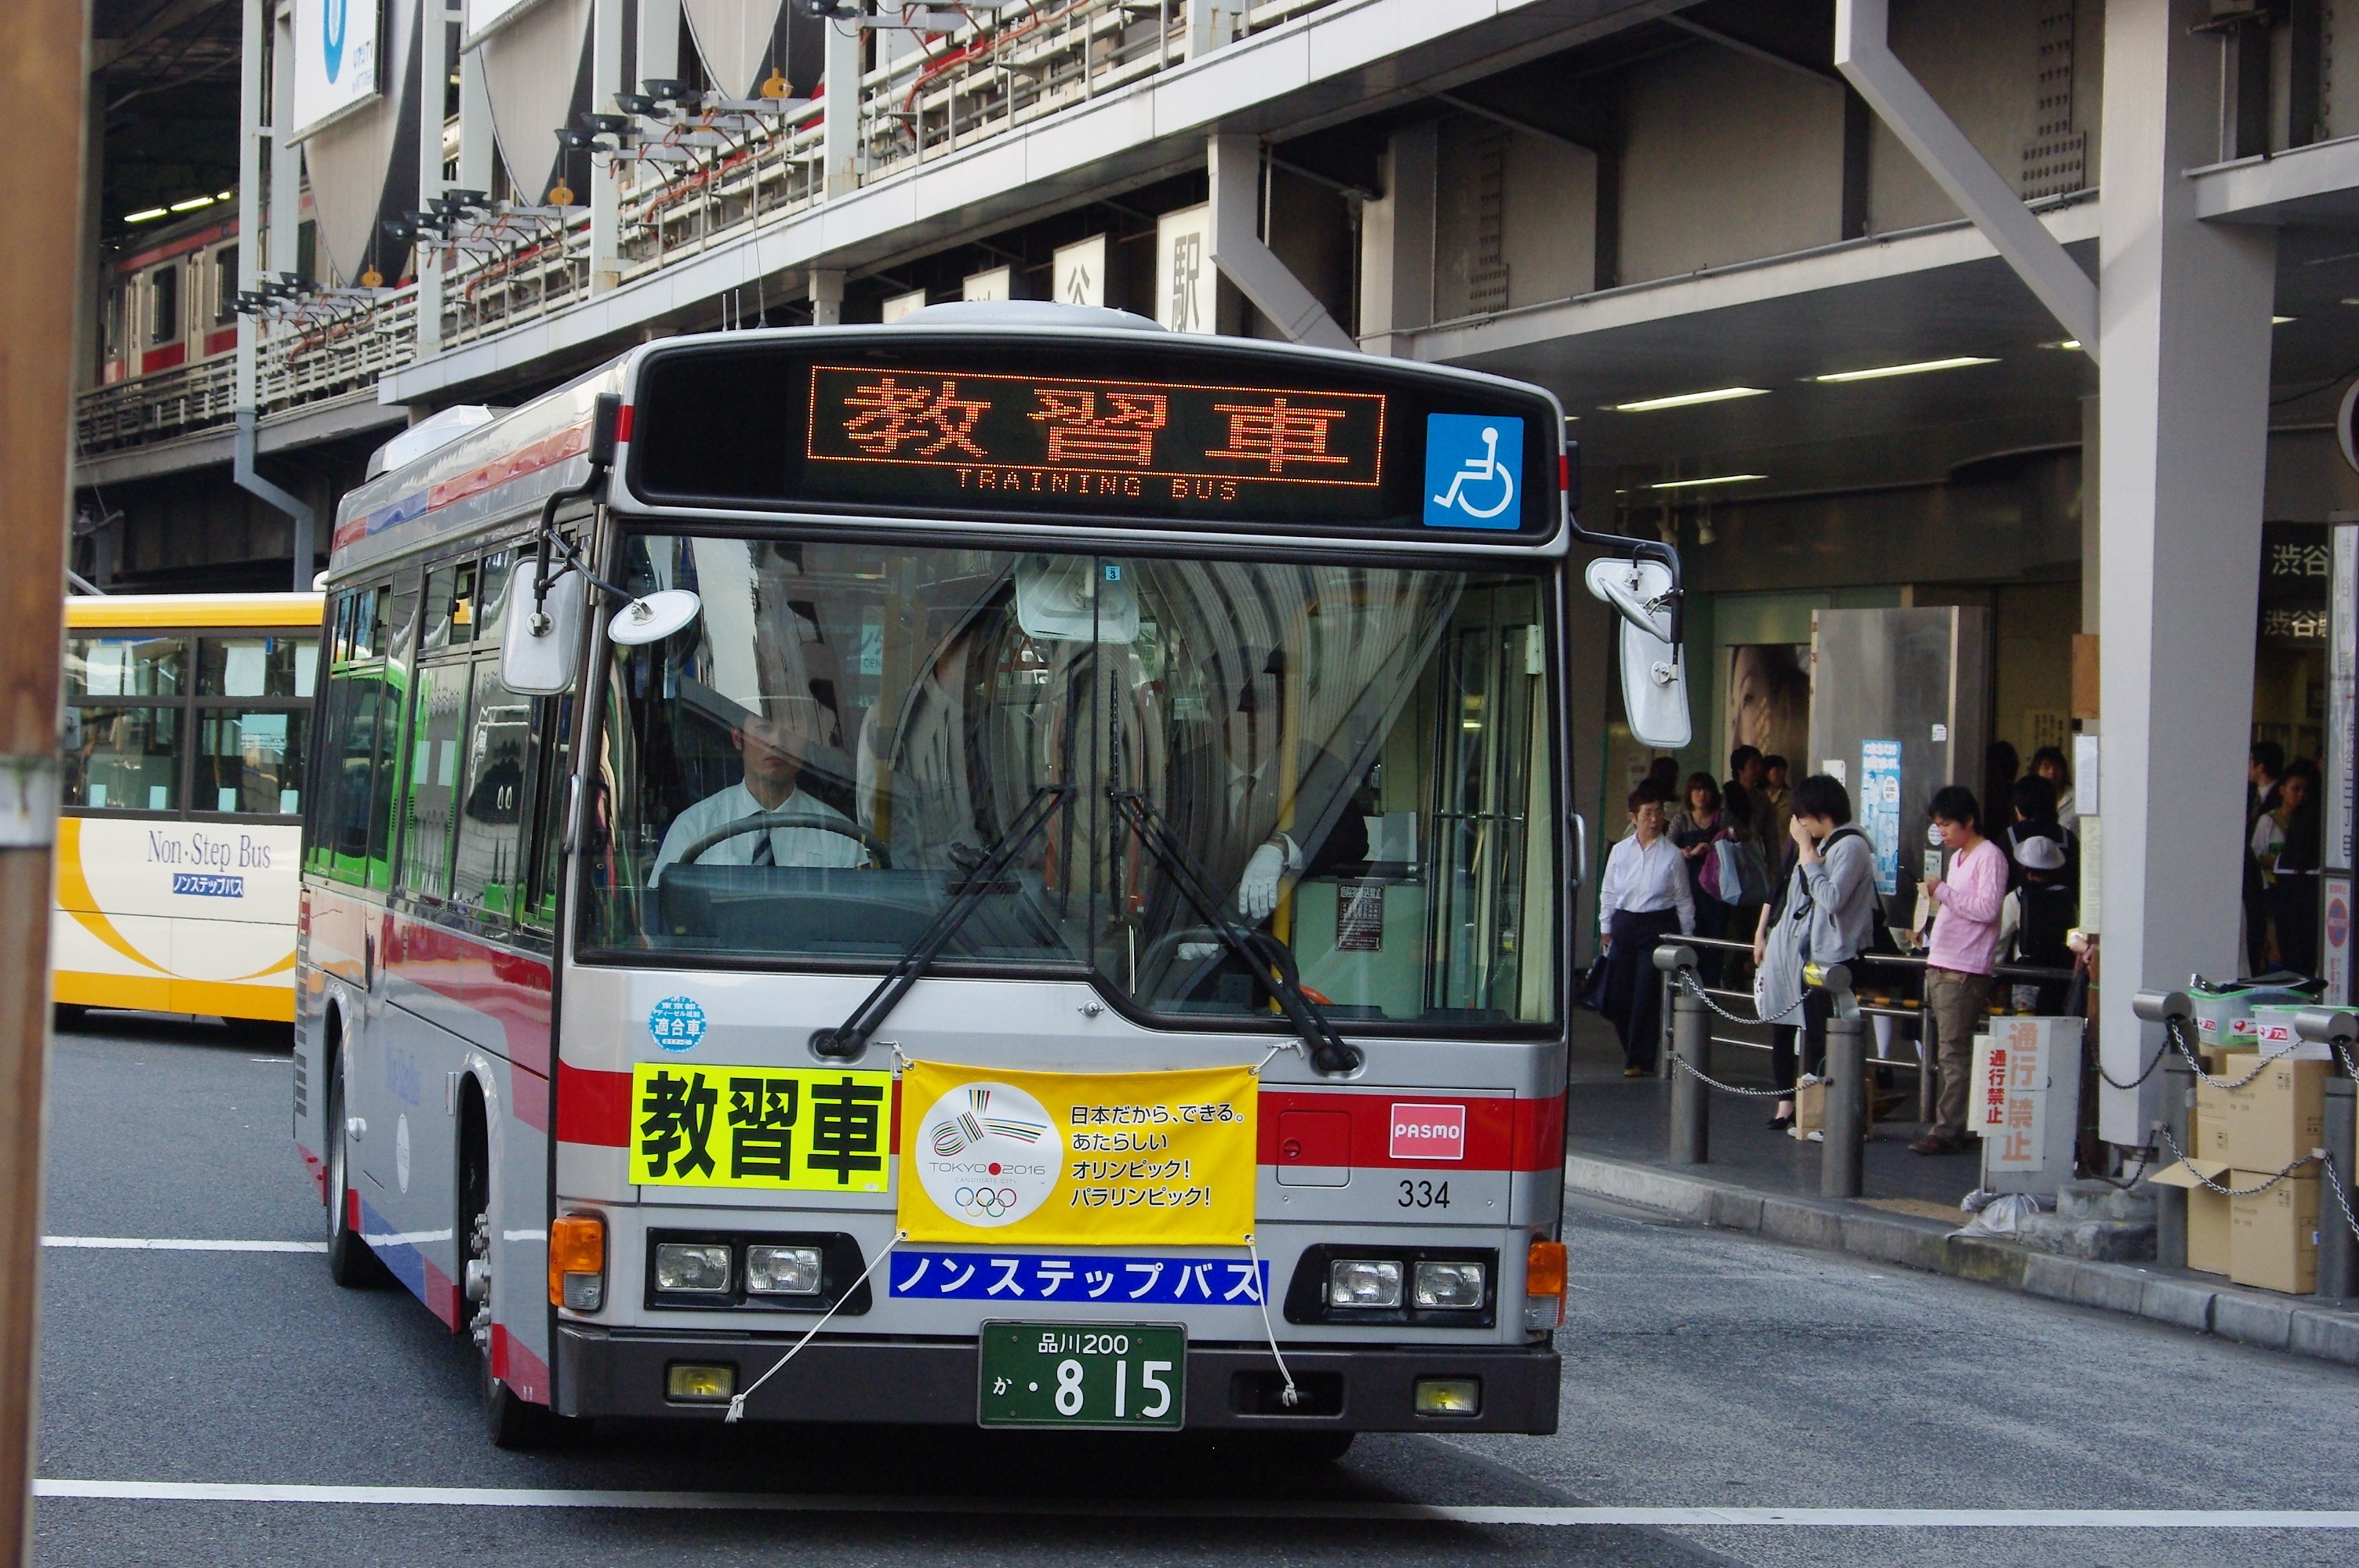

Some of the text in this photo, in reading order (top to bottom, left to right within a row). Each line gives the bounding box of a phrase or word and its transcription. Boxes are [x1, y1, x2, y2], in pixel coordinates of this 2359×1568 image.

[842, 378, 1350, 472] 教習車
[955, 468, 1239, 500] TRAINING BUS
[2272, 543, 2329, 576] 渋谷
[238, 834, 271, 869] Bus
[655, 1018, 701, 1036] 適合車
[1986, 1049, 2006, 1124] 通行禁止
[2002, 1022, 2038, 1162] 通行禁止
[640, 1070, 884, 1185] 教習車
[1070, 1104, 1245, 1125] 日本だから、できる。
[1072, 1133, 1167, 1151] あたらしい
[1394, 1123, 1460, 1139] PASMO
[929, 1162, 1046, 1176] TOKYO 2016
[1398, 1180, 1450, 1208] 334
[897, 1258, 1261, 1302] ノンステップバス
[1038, 1333, 1129, 1355] 品川200
[992, 1376, 1012, 1396] か
